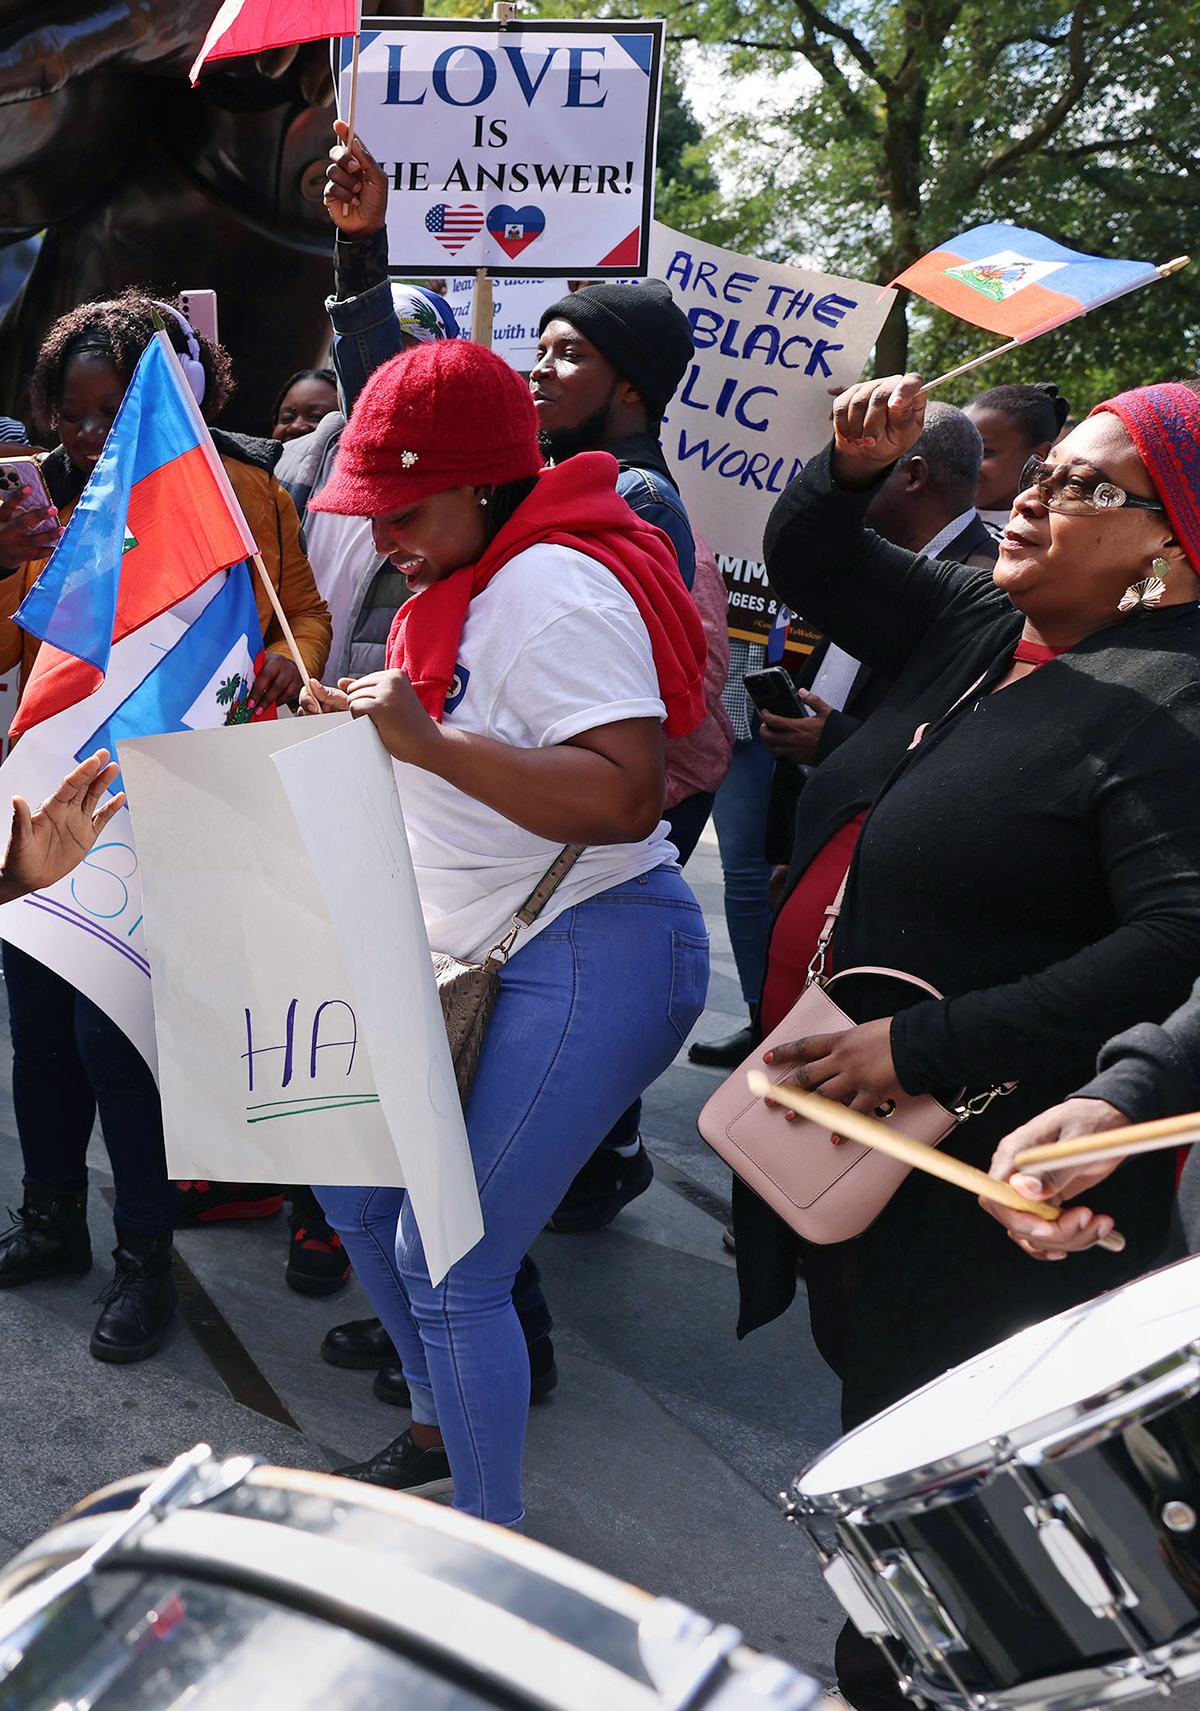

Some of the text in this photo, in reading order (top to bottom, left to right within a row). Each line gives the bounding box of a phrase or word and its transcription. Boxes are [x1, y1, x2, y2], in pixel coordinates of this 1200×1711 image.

[380, 44, 608, 108] LOVE
[376, 161, 429, 192] HE
[453, 279, 476, 293] leav
[665, 250, 859, 329] ARE THE
[493, 323, 525, 340] with
[688, 307, 845, 378] BLACK
[677, 364, 779, 432] LIC
